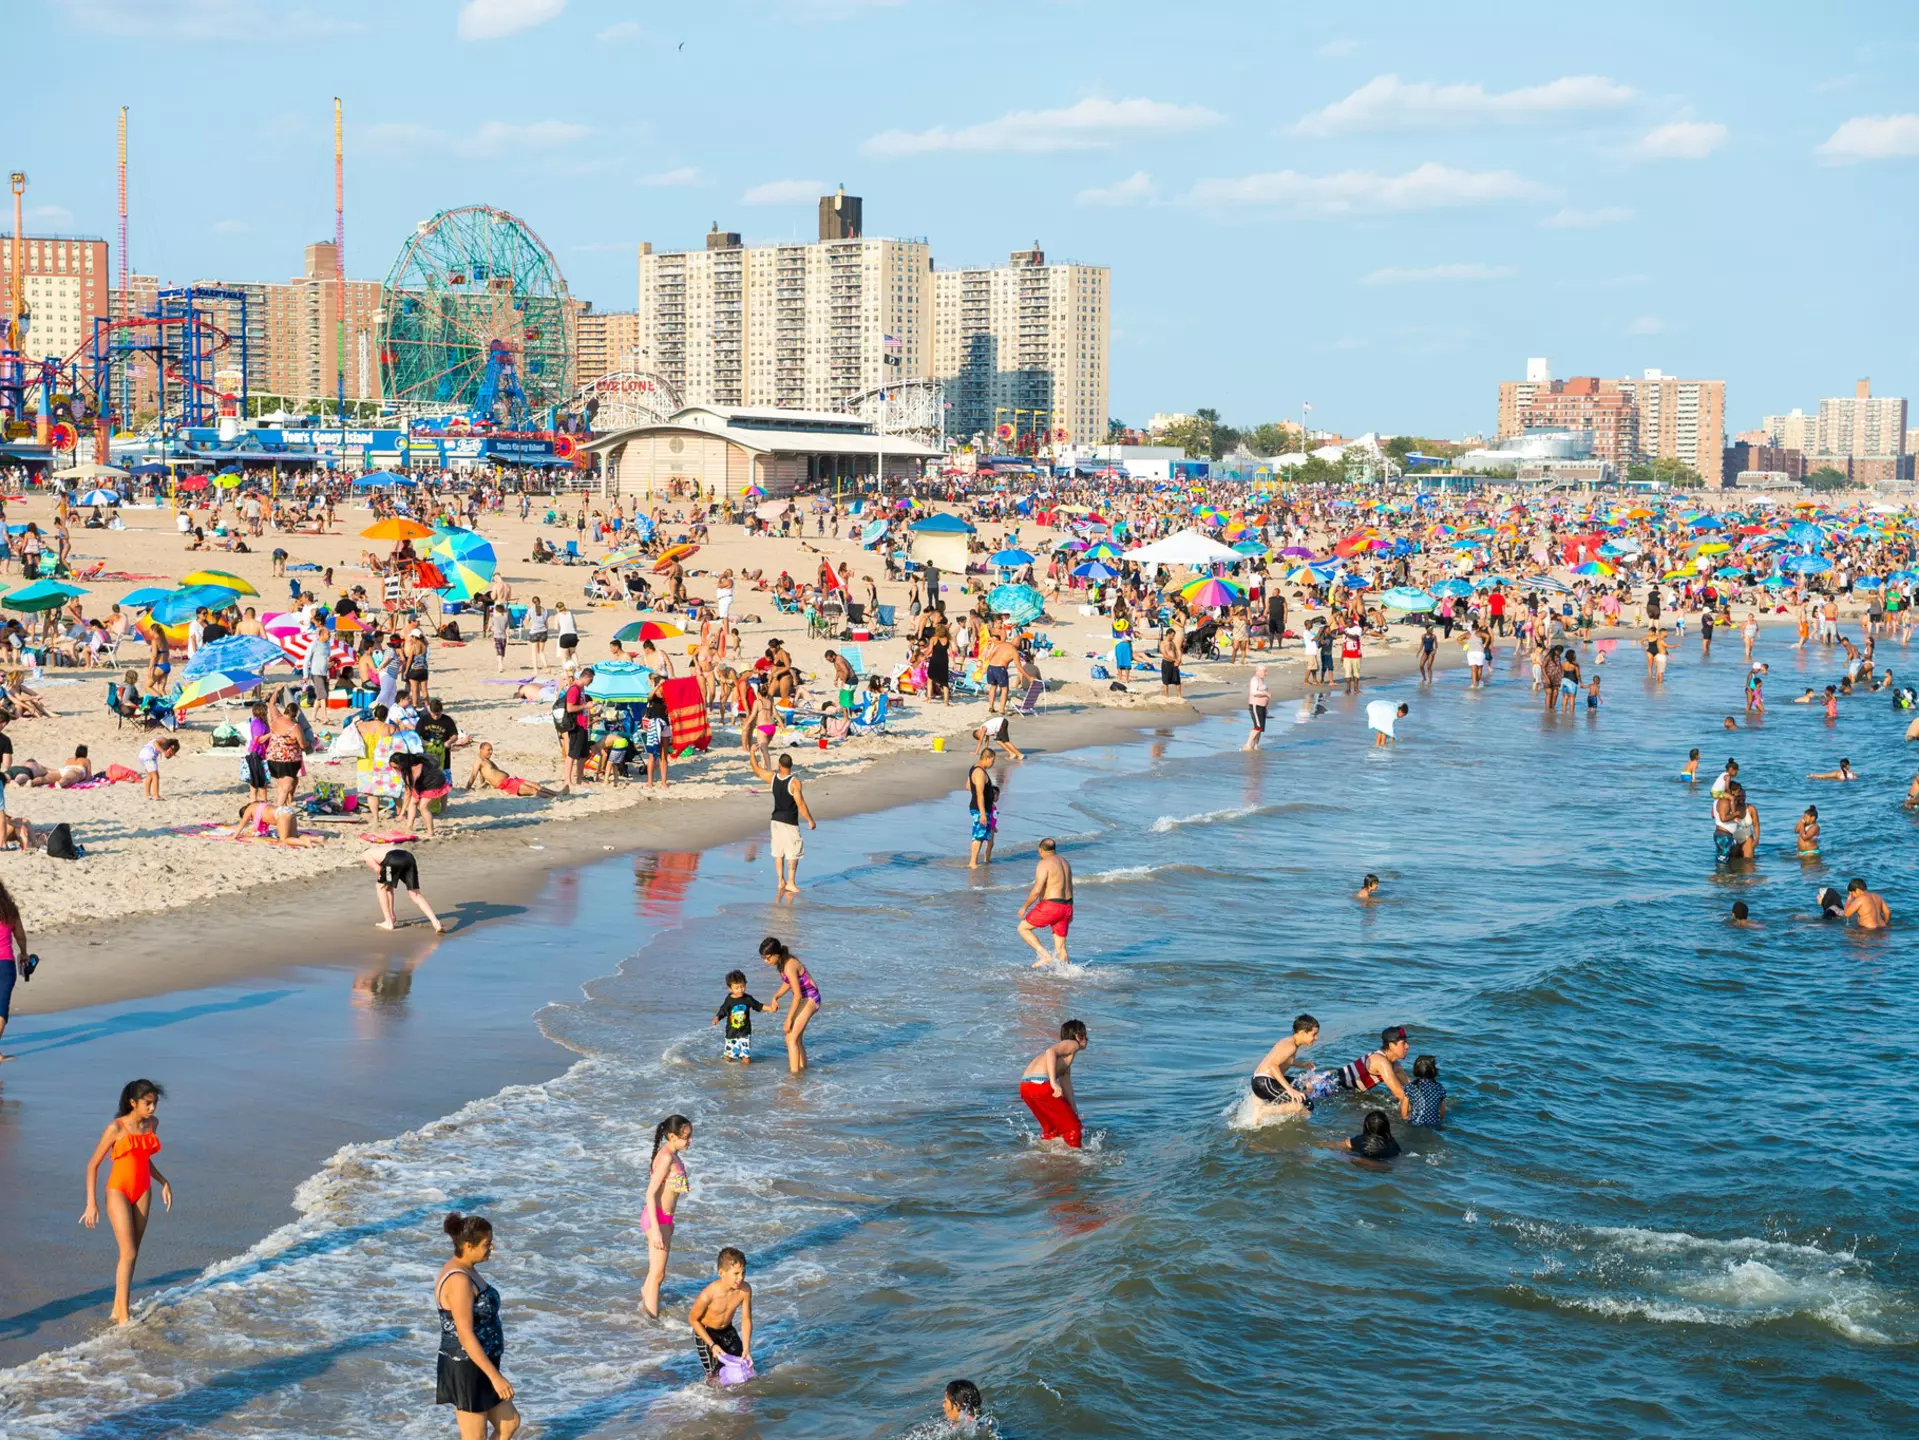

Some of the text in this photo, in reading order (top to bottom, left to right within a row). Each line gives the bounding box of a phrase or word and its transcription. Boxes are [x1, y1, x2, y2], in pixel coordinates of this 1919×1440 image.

[596, 380, 655, 392] CYCLONE
[281, 430, 373, 445] Tom's Coney Island
